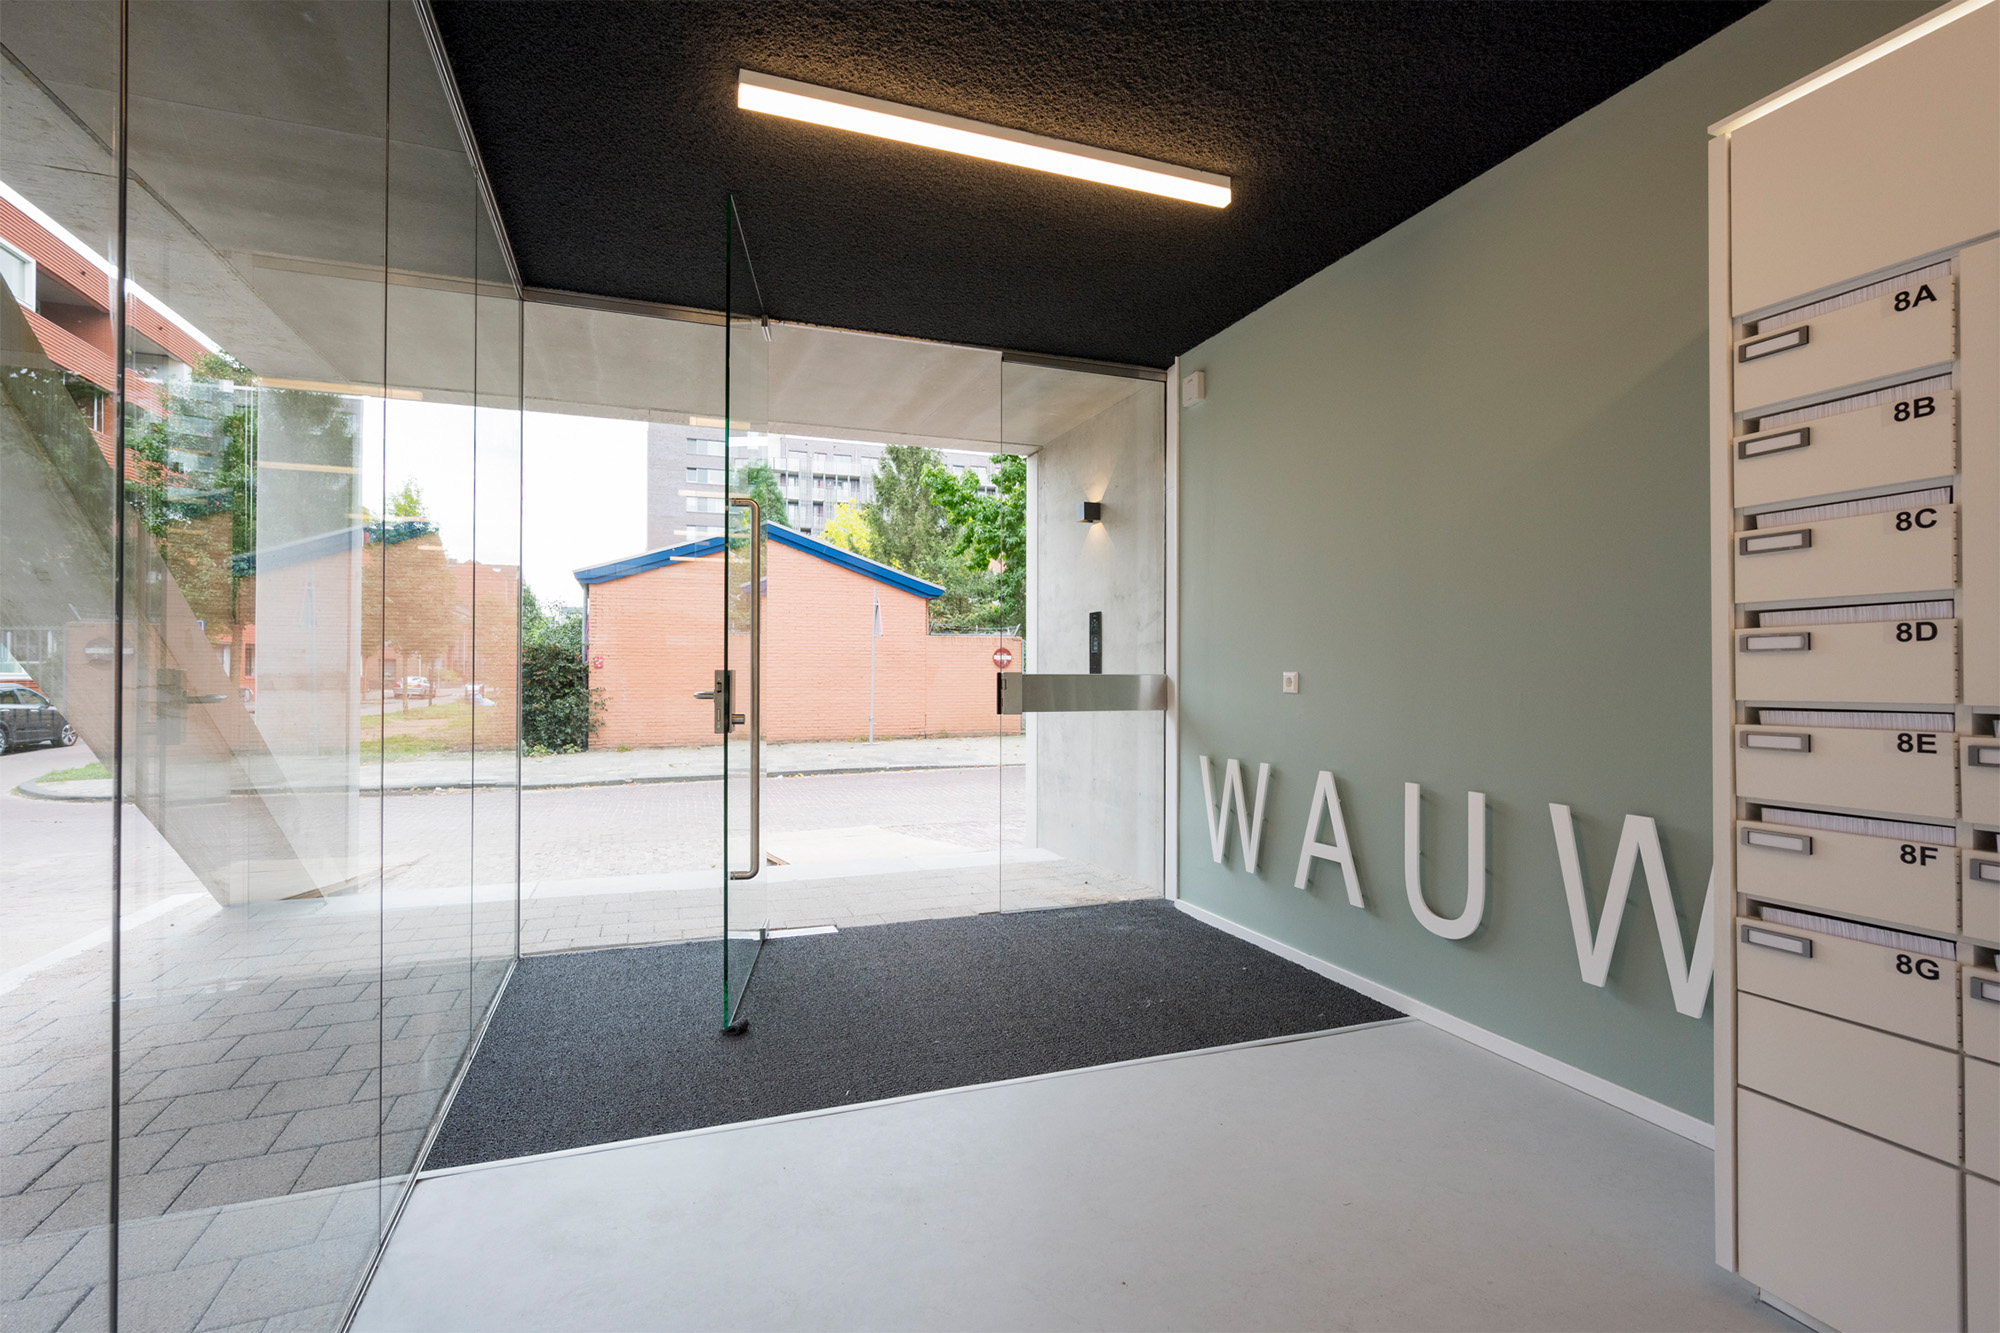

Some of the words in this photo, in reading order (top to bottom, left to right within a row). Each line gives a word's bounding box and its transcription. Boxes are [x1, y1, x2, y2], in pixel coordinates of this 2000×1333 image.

[1893, 283, 1938, 313] 8A
[1893, 396, 1936, 423] 8B
[1895, 507, 1938, 532] 8C
[1895, 621, 1938, 643] 8D
[1896, 732, 1938, 755] 8E
[1899, 843, 1939, 867] 8F
[1199, 754, 1714, 1019] WAUW
[1895, 953, 1940, 981] 8G
